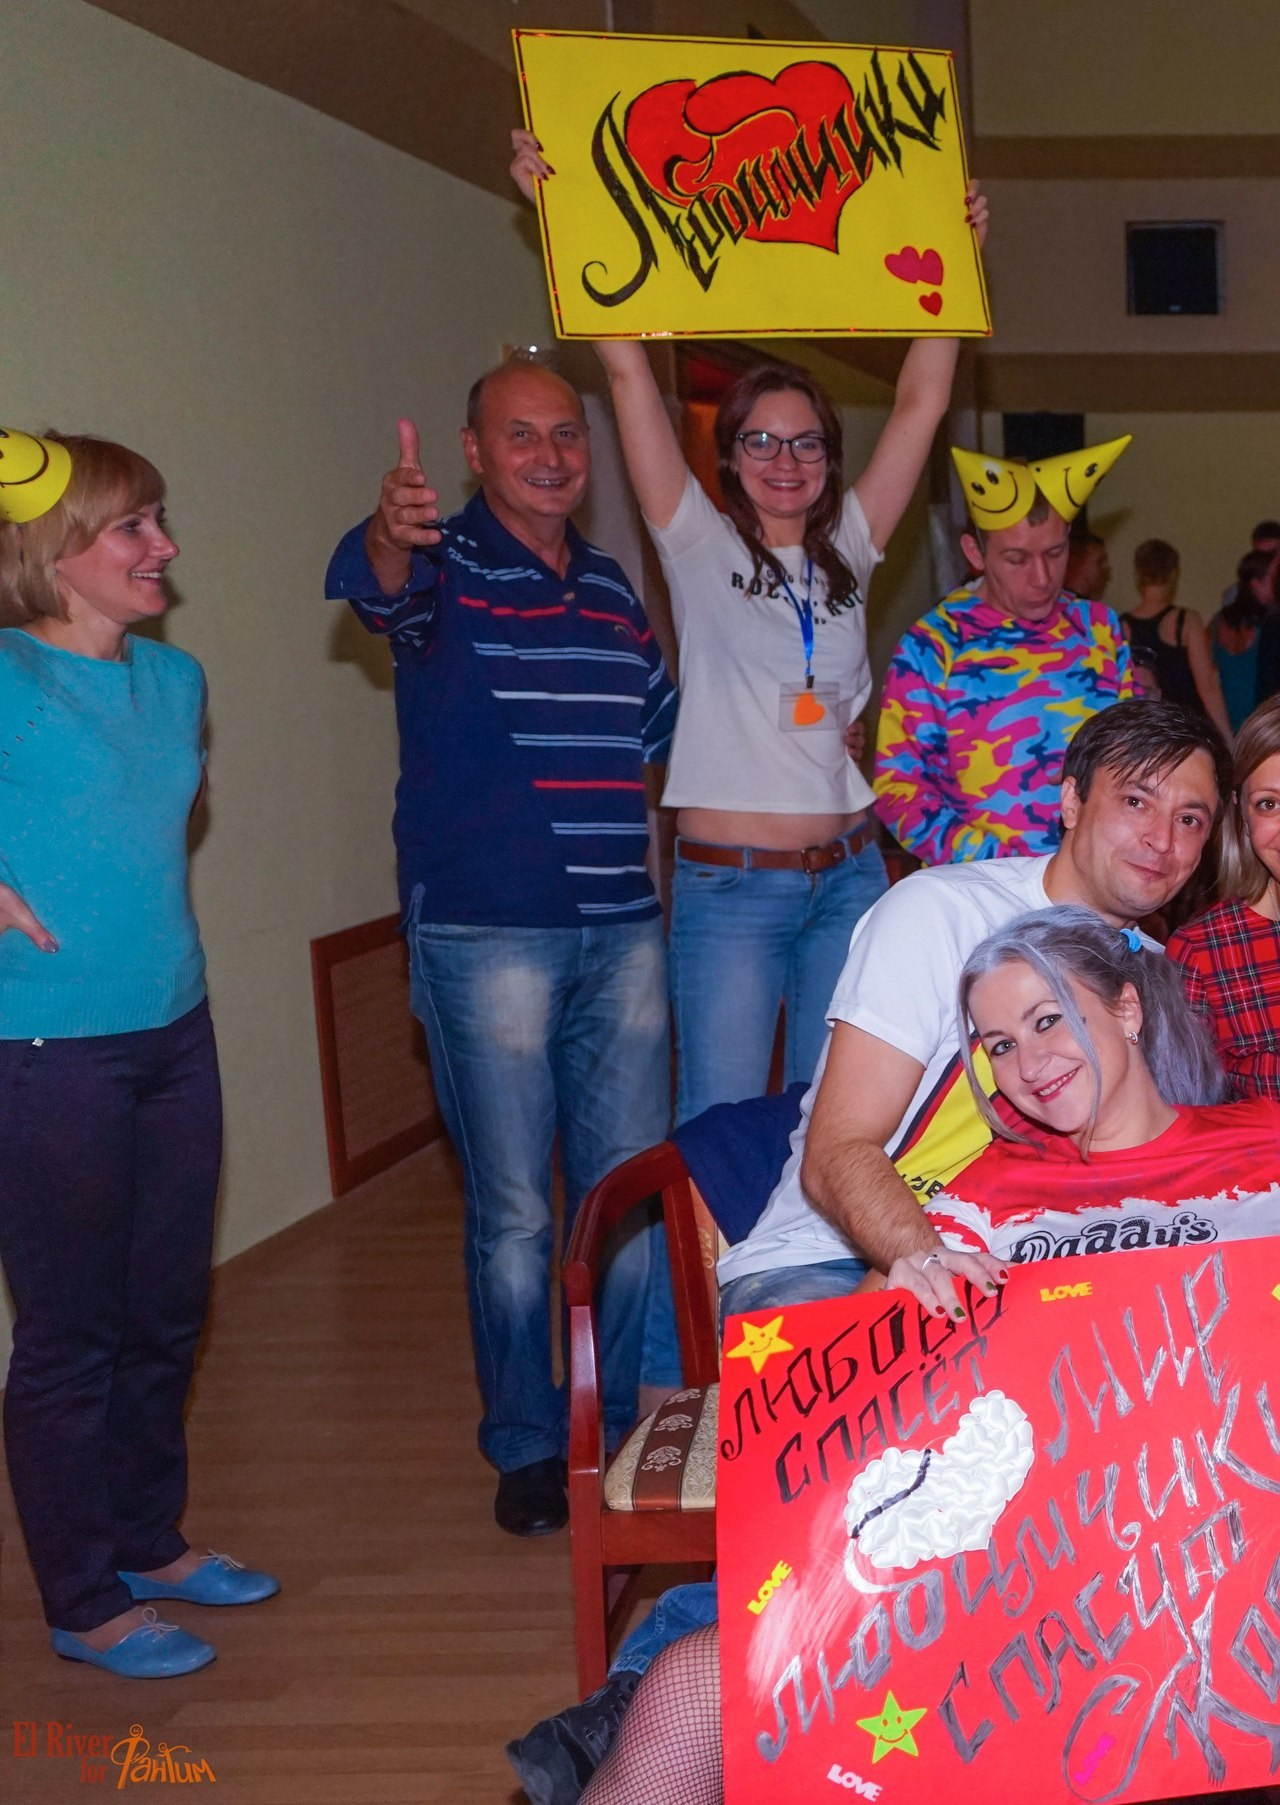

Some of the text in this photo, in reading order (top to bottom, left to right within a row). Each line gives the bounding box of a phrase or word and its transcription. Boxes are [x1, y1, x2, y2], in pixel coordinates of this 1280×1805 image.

[1040, 1281, 1093, 1302] LOVE
[775, 1335, 988, 1505] СПАСЁТ
[747, 1560, 793, 1616] LOVE
[827, 1763, 883, 1802] LOVE
